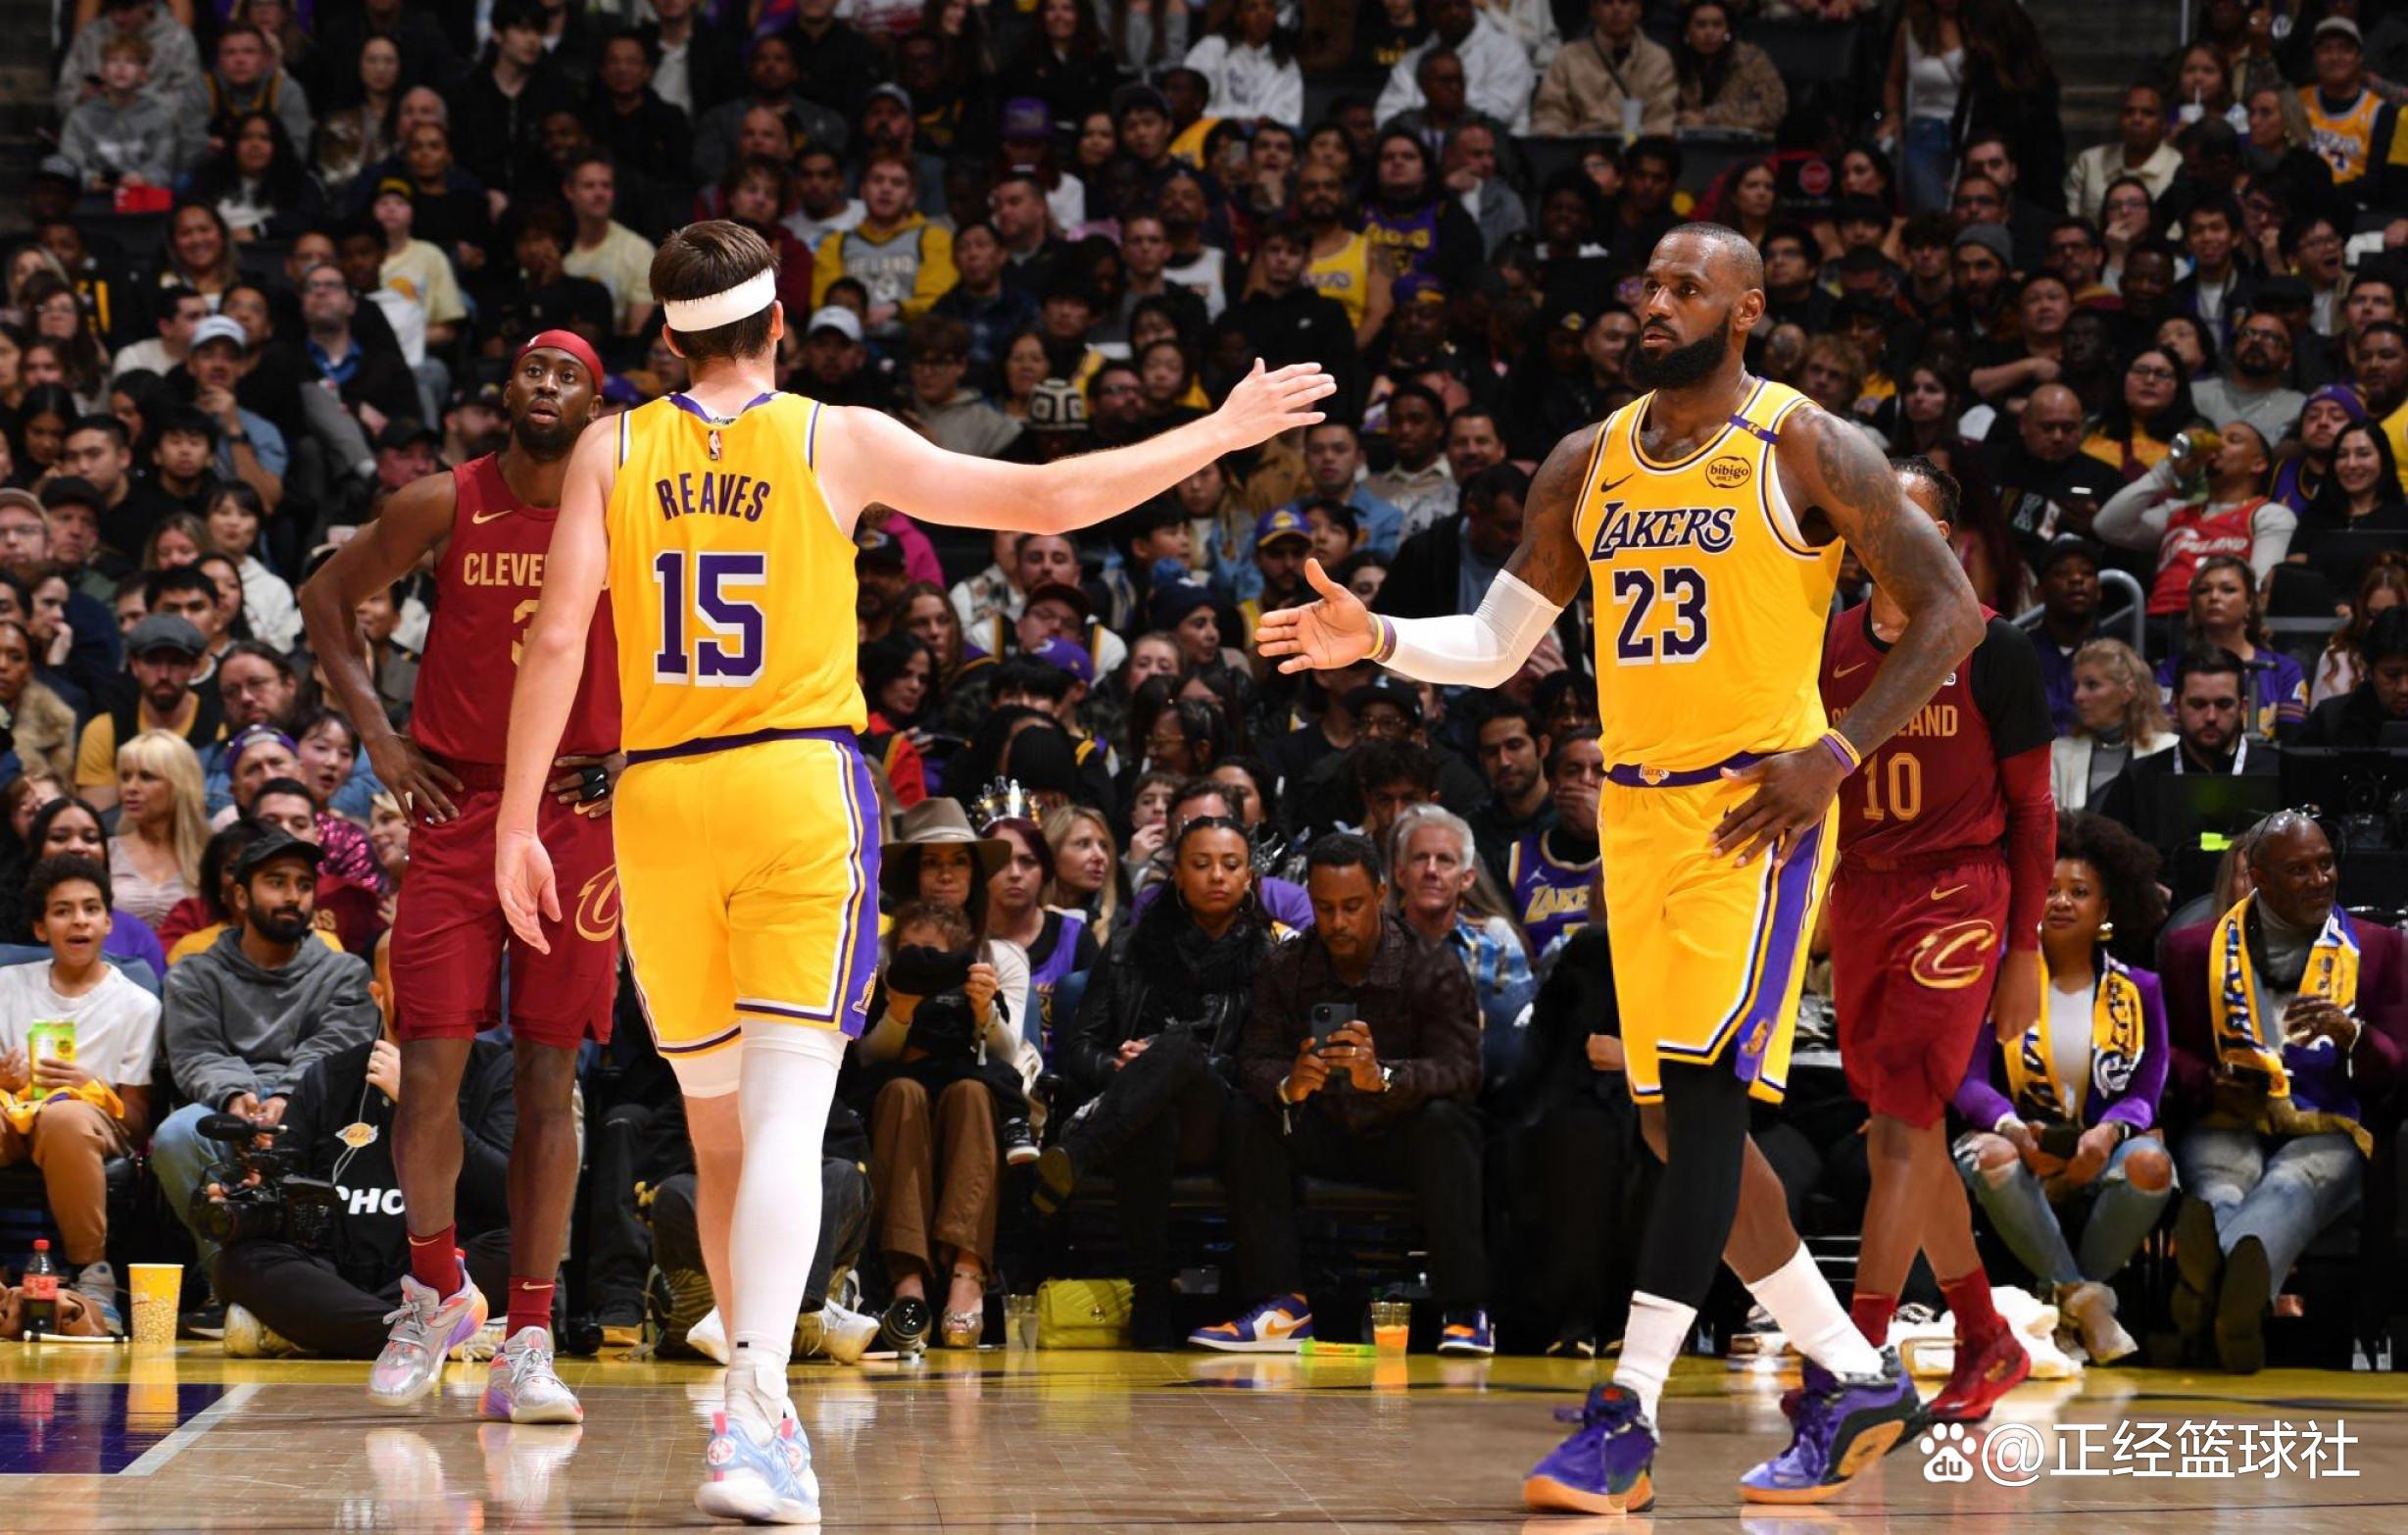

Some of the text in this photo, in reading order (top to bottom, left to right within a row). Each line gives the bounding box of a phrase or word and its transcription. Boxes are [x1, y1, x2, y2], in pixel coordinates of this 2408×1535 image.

[656, 471, 771, 522] REAVES
[1710, 465, 1749, 479] bibigo
[1589, 500, 1739, 563] LAKERS
[464, 552, 549, 587] CLEVE
[653, 550, 767, 687] 15
[1612, 566, 1709, 668] 23
[1863, 751, 1922, 821] 10
